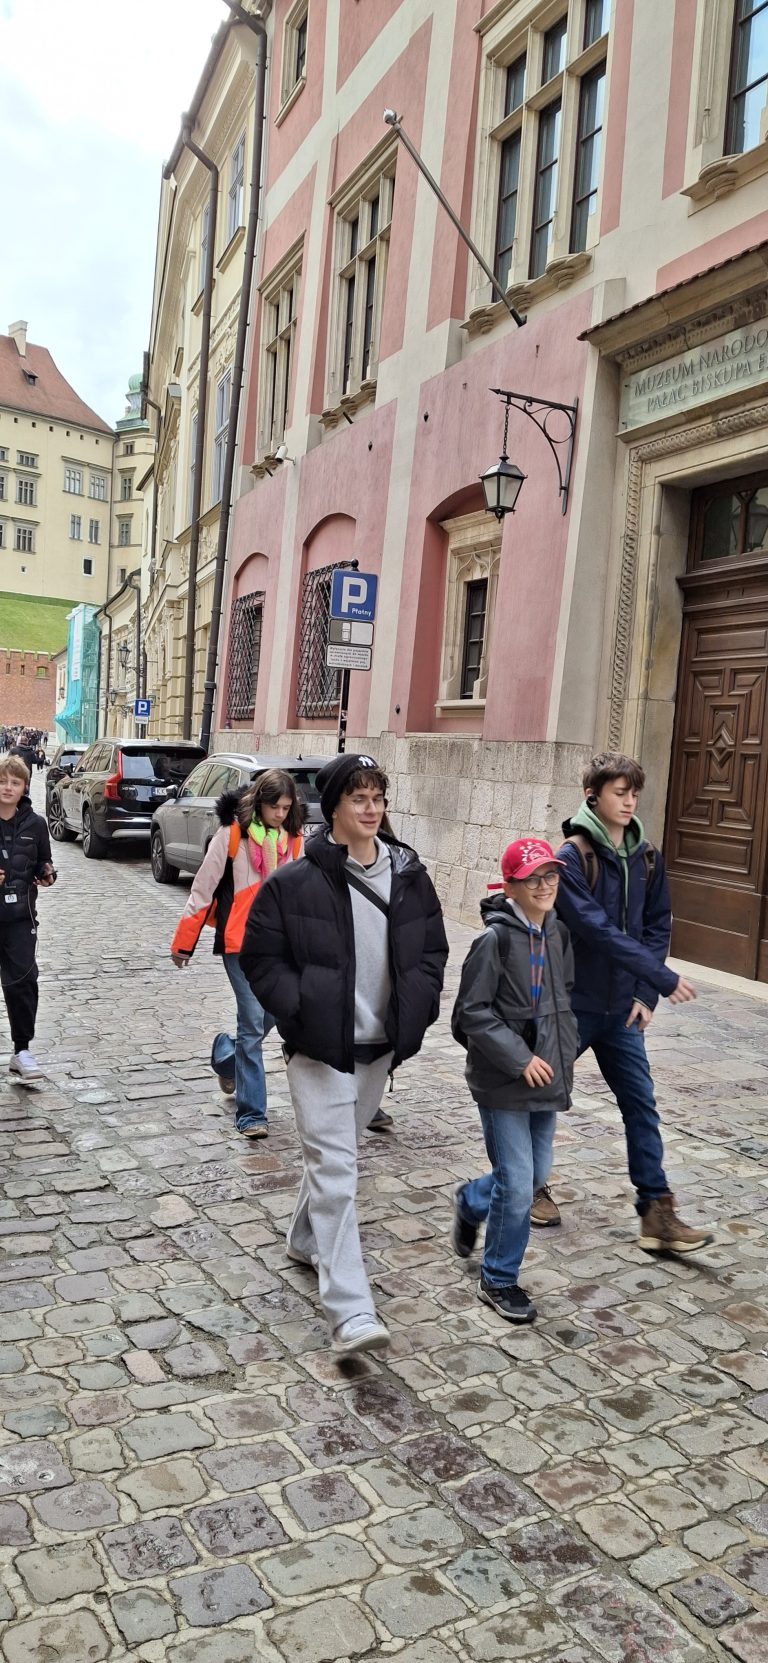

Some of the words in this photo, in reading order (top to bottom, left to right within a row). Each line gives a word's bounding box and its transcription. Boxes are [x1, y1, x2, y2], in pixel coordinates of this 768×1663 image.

[634, 359, 695, 397] MUZEUM
[692, 359, 752, 396] BISKUPA
[341, 576, 368, 612] P
[138, 701, 148, 714] P
